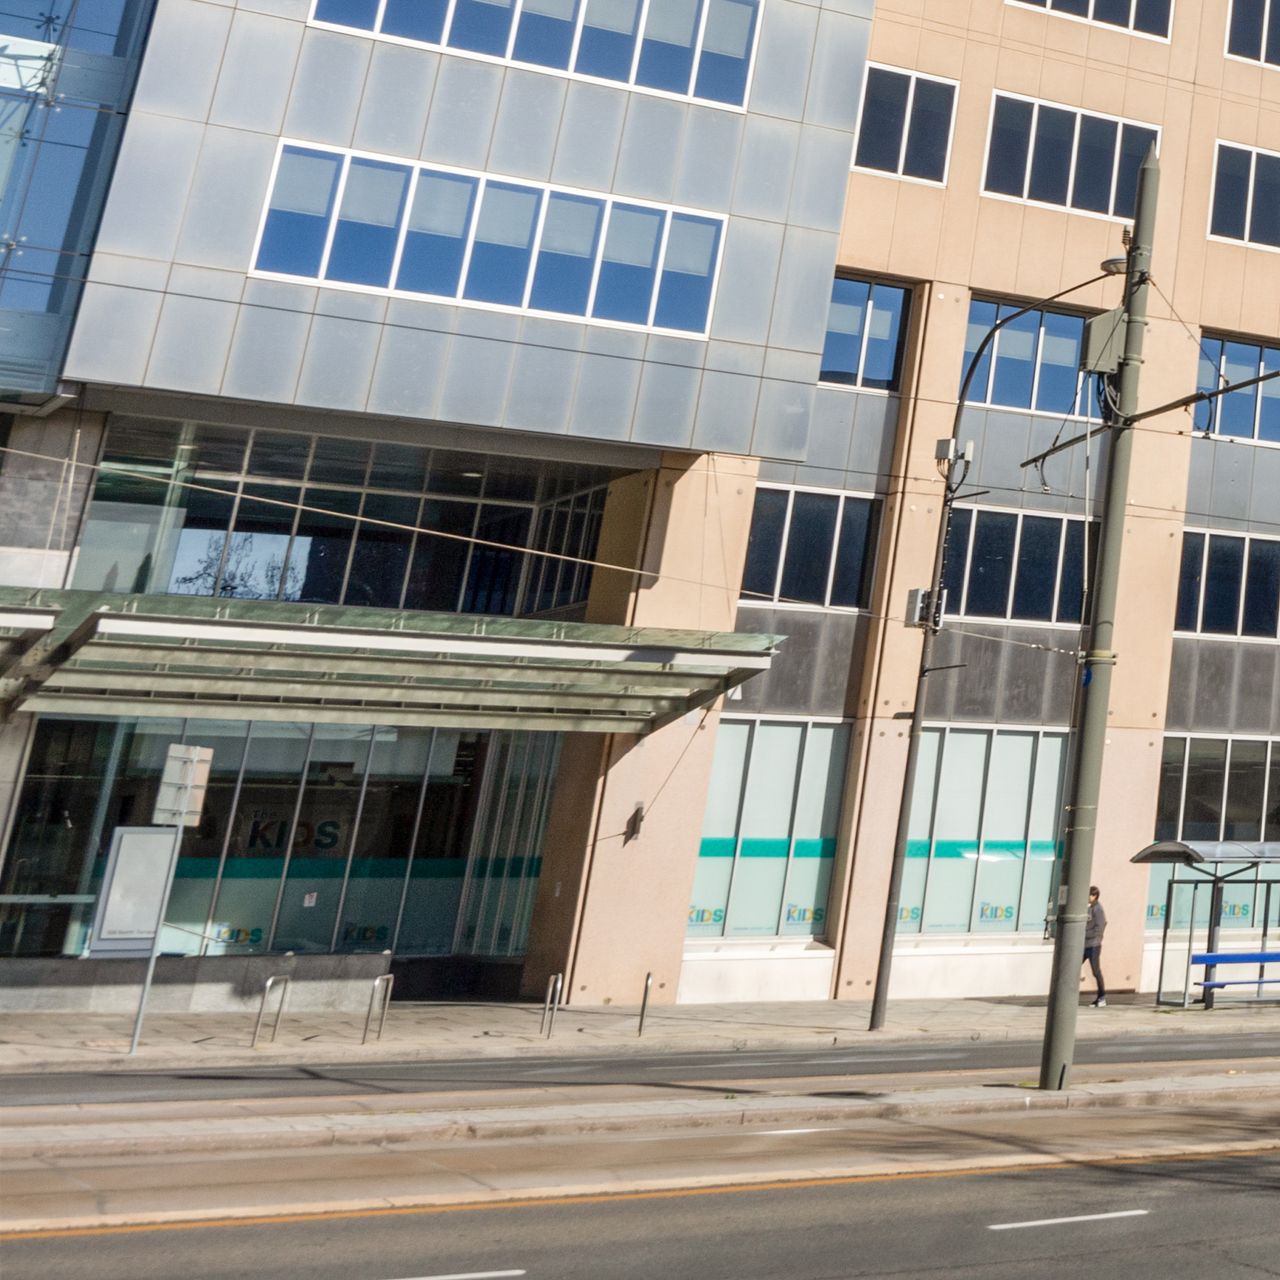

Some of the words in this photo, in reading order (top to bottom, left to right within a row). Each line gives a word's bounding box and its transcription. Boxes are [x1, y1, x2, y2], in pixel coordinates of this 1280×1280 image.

[248, 820, 342, 850] KIDS
[786, 907, 824, 923] KIDS
[980, 905, 1014, 920] KIDS
